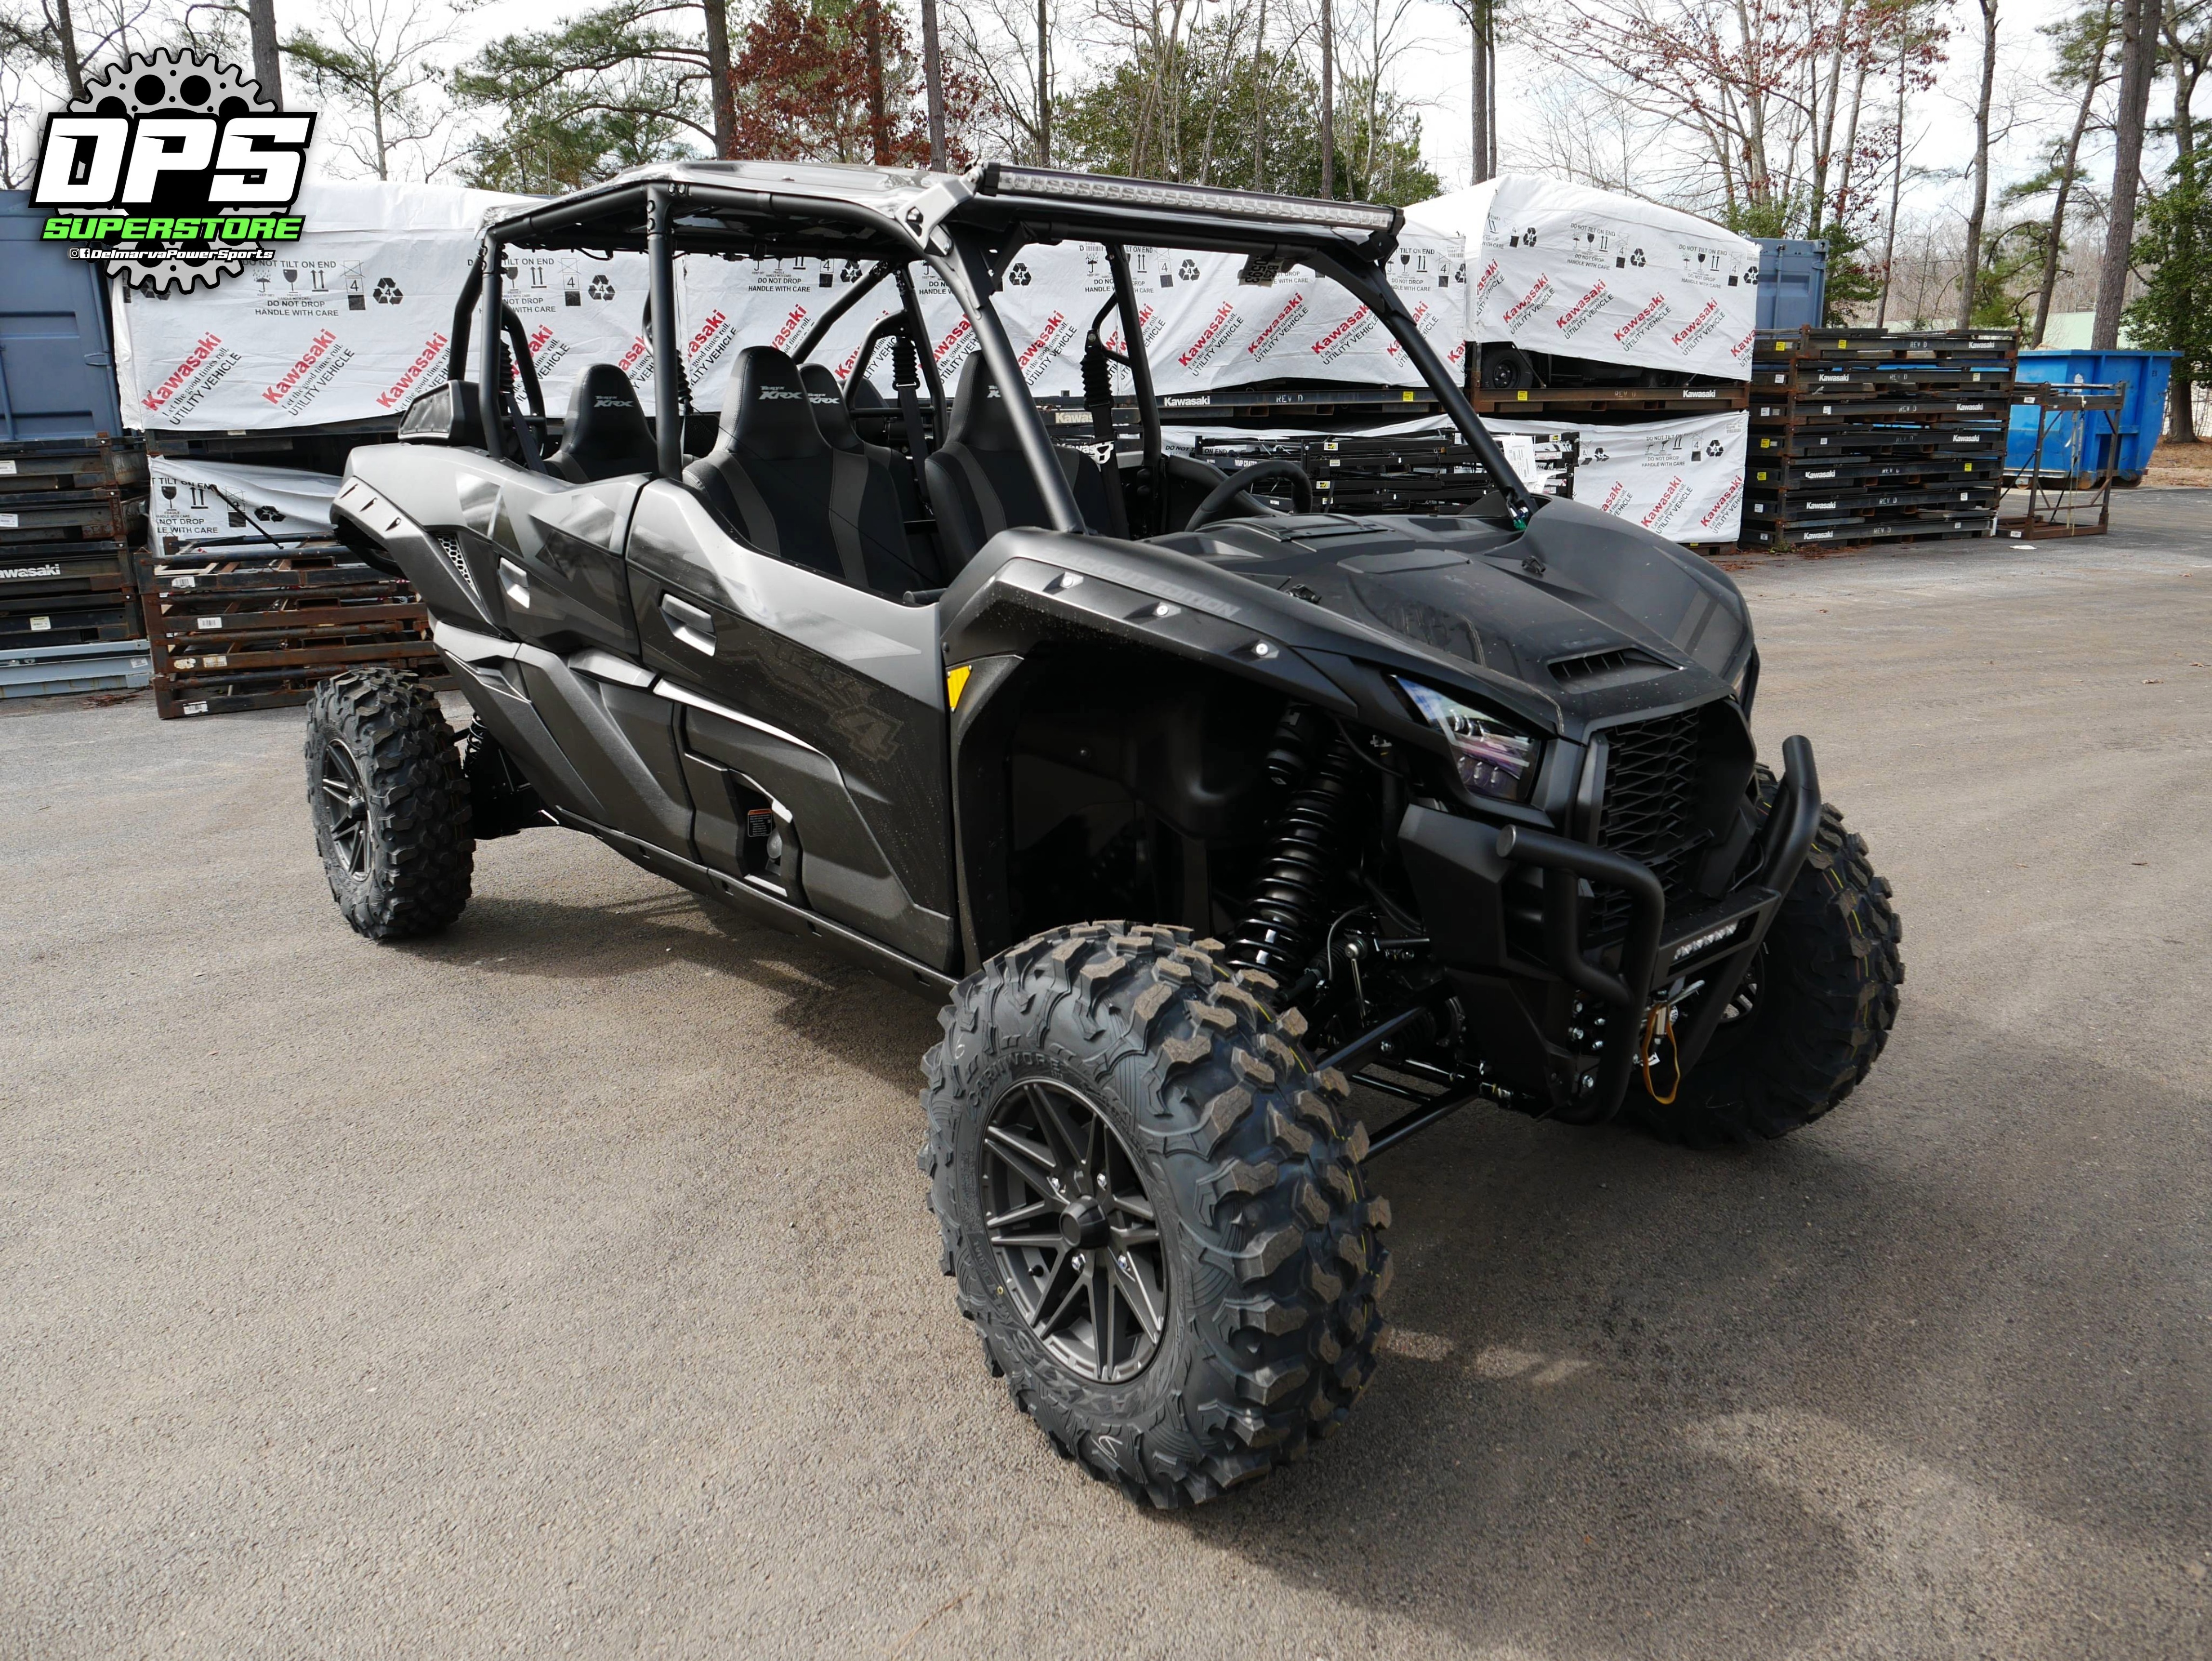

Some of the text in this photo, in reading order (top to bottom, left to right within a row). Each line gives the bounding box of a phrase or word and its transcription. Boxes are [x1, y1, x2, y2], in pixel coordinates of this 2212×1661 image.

[823, 261, 830, 271] 4
[1162, 263, 1168, 272] 4
[1245, 256, 1268, 283] 0593
[1441, 264, 1446, 273] 4
[1620, 247, 1623, 255] 4
[351, 280, 358, 291] 4
[567, 277, 575, 288] 4
[1502, 272, 1548, 324] Kawasaki
[1556, 279, 1606, 329] Kawasaki
[1178, 301, 1233, 367] Kawasaki
[1204, 313, 1237, 352] good times roll.
[1248, 292, 1303, 354] Kawasaki
[1255, 307, 1309, 363] UTILITY VEHICLE
[1311, 301, 1369, 355] Kawasak
[1510, 288, 1555, 335] UTILITY VEHICLE
[1564, 293, 1614, 340] UTILITY VEHICLE
[1613, 292, 1664, 342] Kawasaki
[1623, 306, 1672, 352] UTILITY VEHICLE
[1671, 297, 1718, 346] Kawasaki
[1682, 311, 1725, 356] UTILITY VEHICLE
[532, 343, 570, 379] VEHICLE
[705, 327, 737, 364] VEHICLE
[1017, 310, 1065, 369] awasaki
[1025, 326, 1078, 386] UTILITY VEHICLE
[1192, 316, 1244, 377] UTILITY VEHICLE
[1323, 341, 1351, 365] UTILITY
[141, 332, 222, 411] Kawasaki
[161, 347, 229, 417] Let the good times roll.
[169, 352, 242, 425] UTILITY VEHICLE
[262, 329, 336, 405] Kawasaki
[288, 348, 355, 416] UTILITY VEHICLE
[302, 343, 343, 390] good times roll.
[376, 332, 448, 408] Kawasaki
[759, 391, 803, 399] KRX
[1164, 396, 1210, 406] Kawasaki
[1805, 470, 1835, 478] Kawasaki
[1640, 475, 1682, 527] Kawasaki
[1655, 487, 1693, 534] UTILITY VEHICLE
[1700, 475, 1742, 527] Kawasaki
[1804, 531, 1833, 540] Kawasaki
[0, 563, 60, 579] awasaki
